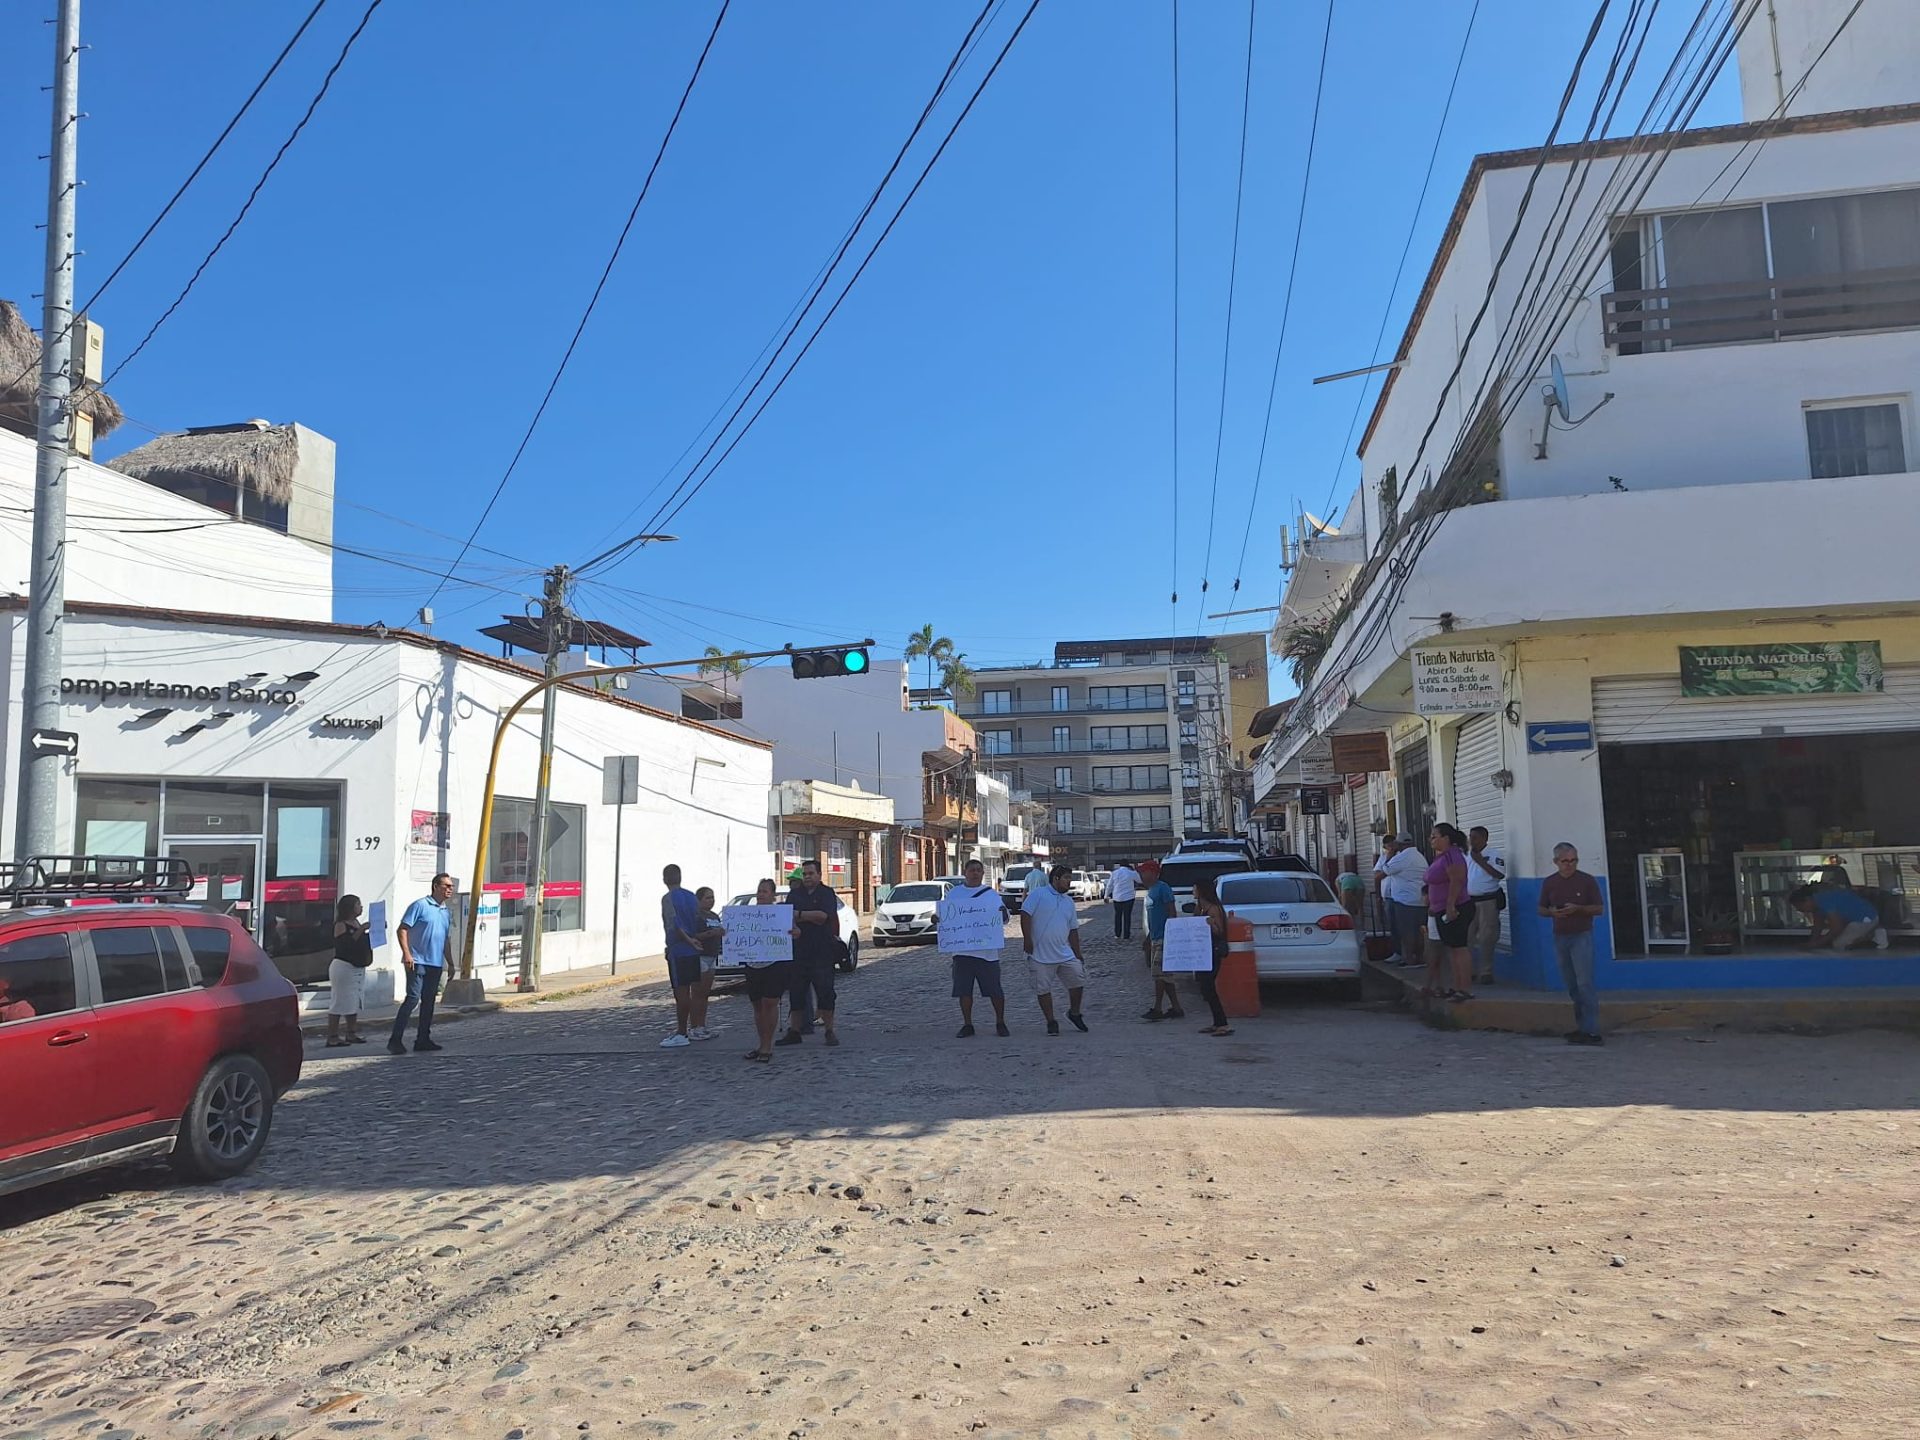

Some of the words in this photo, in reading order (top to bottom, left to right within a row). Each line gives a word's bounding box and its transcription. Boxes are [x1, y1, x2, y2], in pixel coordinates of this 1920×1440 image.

[1416, 652, 1447, 666] Tienda
[1450, 649, 1496, 664] Naturista
[1697, 655, 1754, 666] TIENDA
[1759, 652, 1845, 664] NATURISTA
[1427, 666, 1457, 675] Abierto
[1463, 665, 1475, 673] de
[1419, 677, 1440, 685] Lunes
[61, 678, 221, 701] ompartamos
[228, 682, 296, 705] Banco
[322, 714, 383, 730] Sucursal
[355, 836, 380, 851] 199
